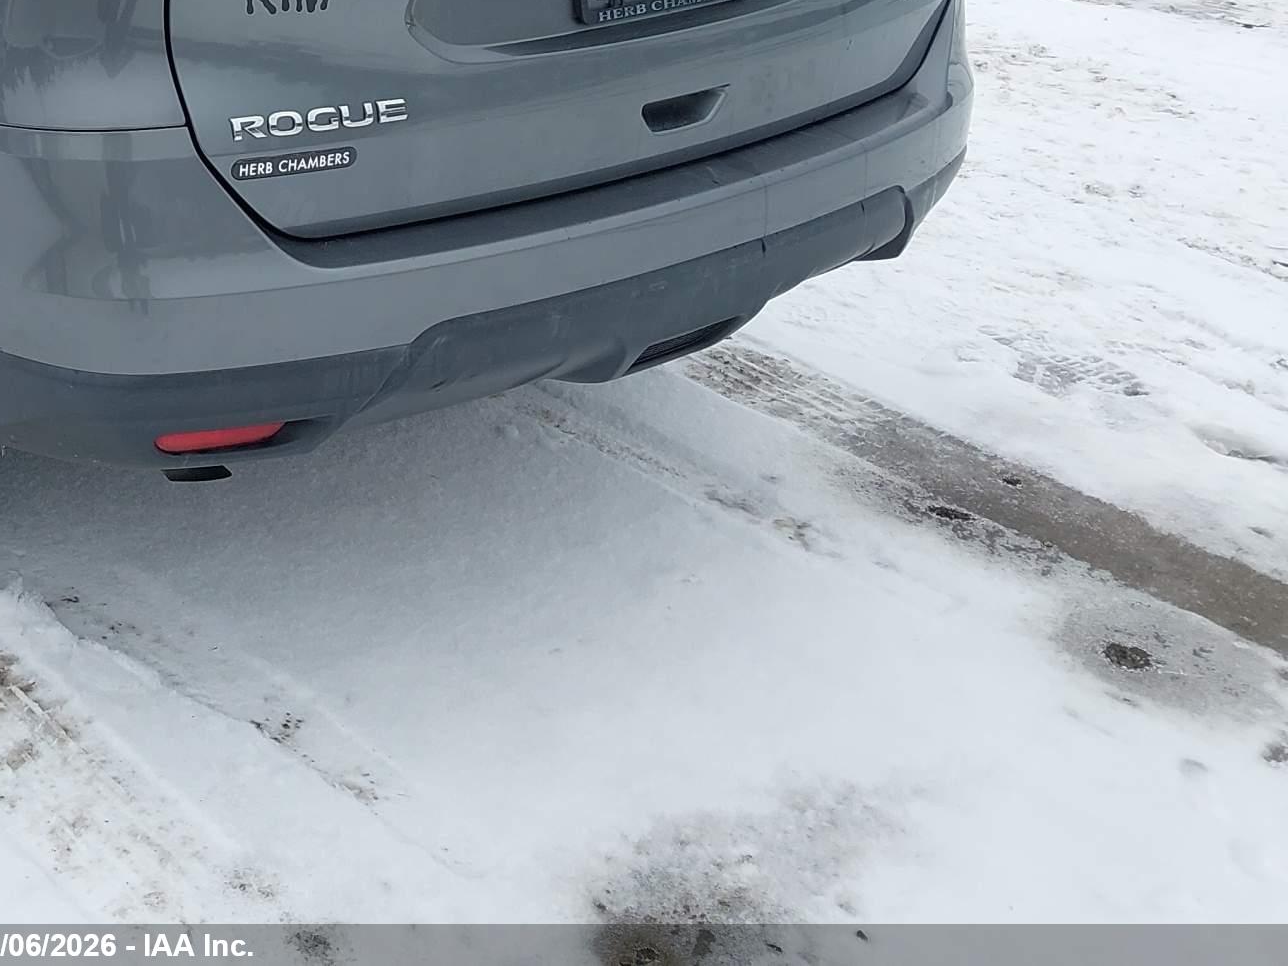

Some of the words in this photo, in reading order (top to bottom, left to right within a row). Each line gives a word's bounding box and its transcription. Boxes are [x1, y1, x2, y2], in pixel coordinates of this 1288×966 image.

[598, 3, 647, 22] HERB
[229, 98, 408, 142] ROGUE
[239, 160, 273, 177] HERB
[278, 151, 350, 173] CHAMBERS
